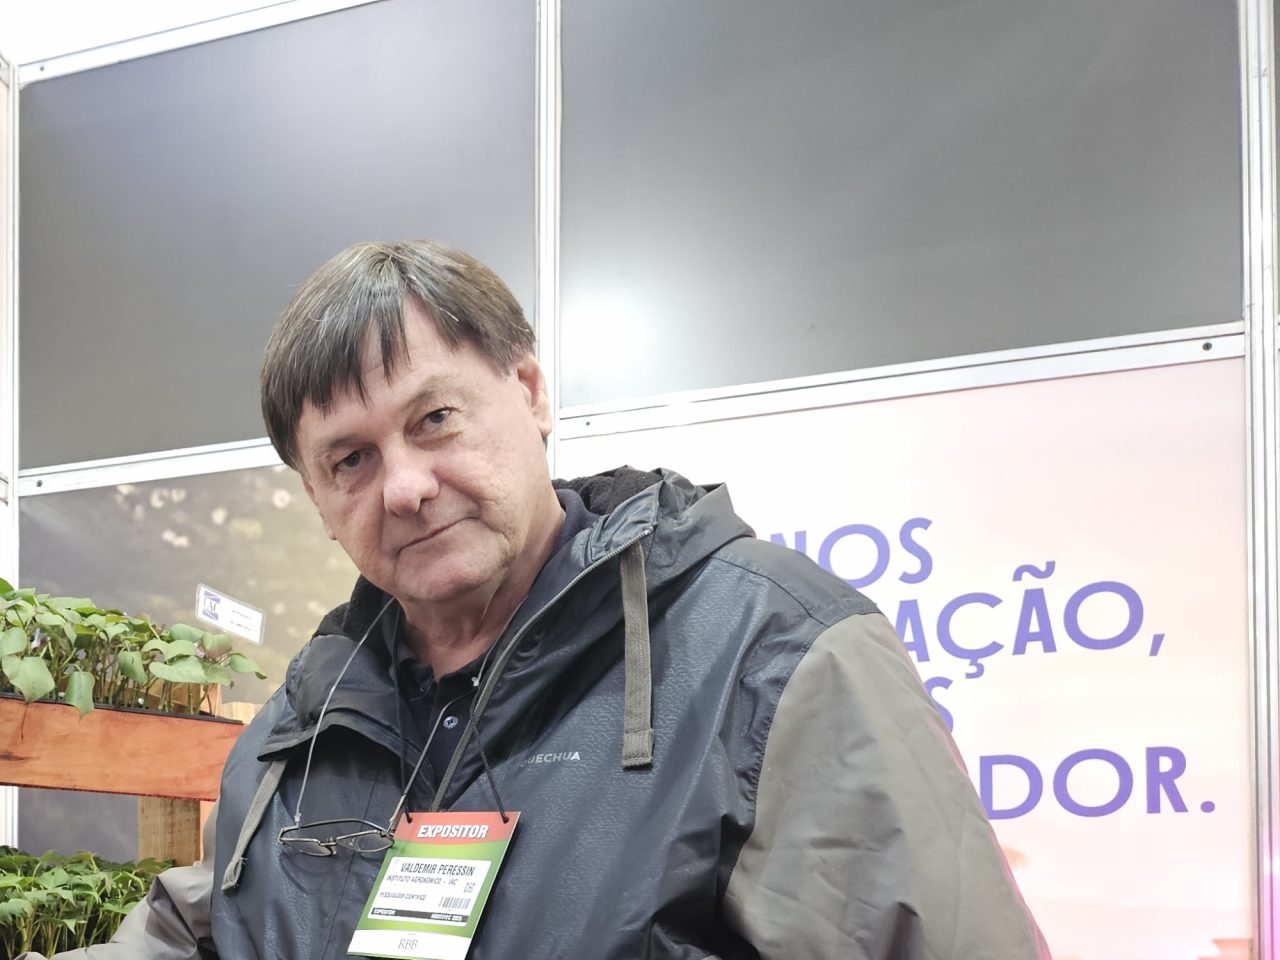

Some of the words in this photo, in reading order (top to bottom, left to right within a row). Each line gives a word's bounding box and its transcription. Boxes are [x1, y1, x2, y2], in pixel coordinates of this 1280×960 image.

[896, 560, 1166, 679] AÇÃO,
[417, 824, 489, 839] EXPOSITOR
[400, 862, 438, 875] VALDEMIR
[437, 864, 476, 877] PERESSIN
